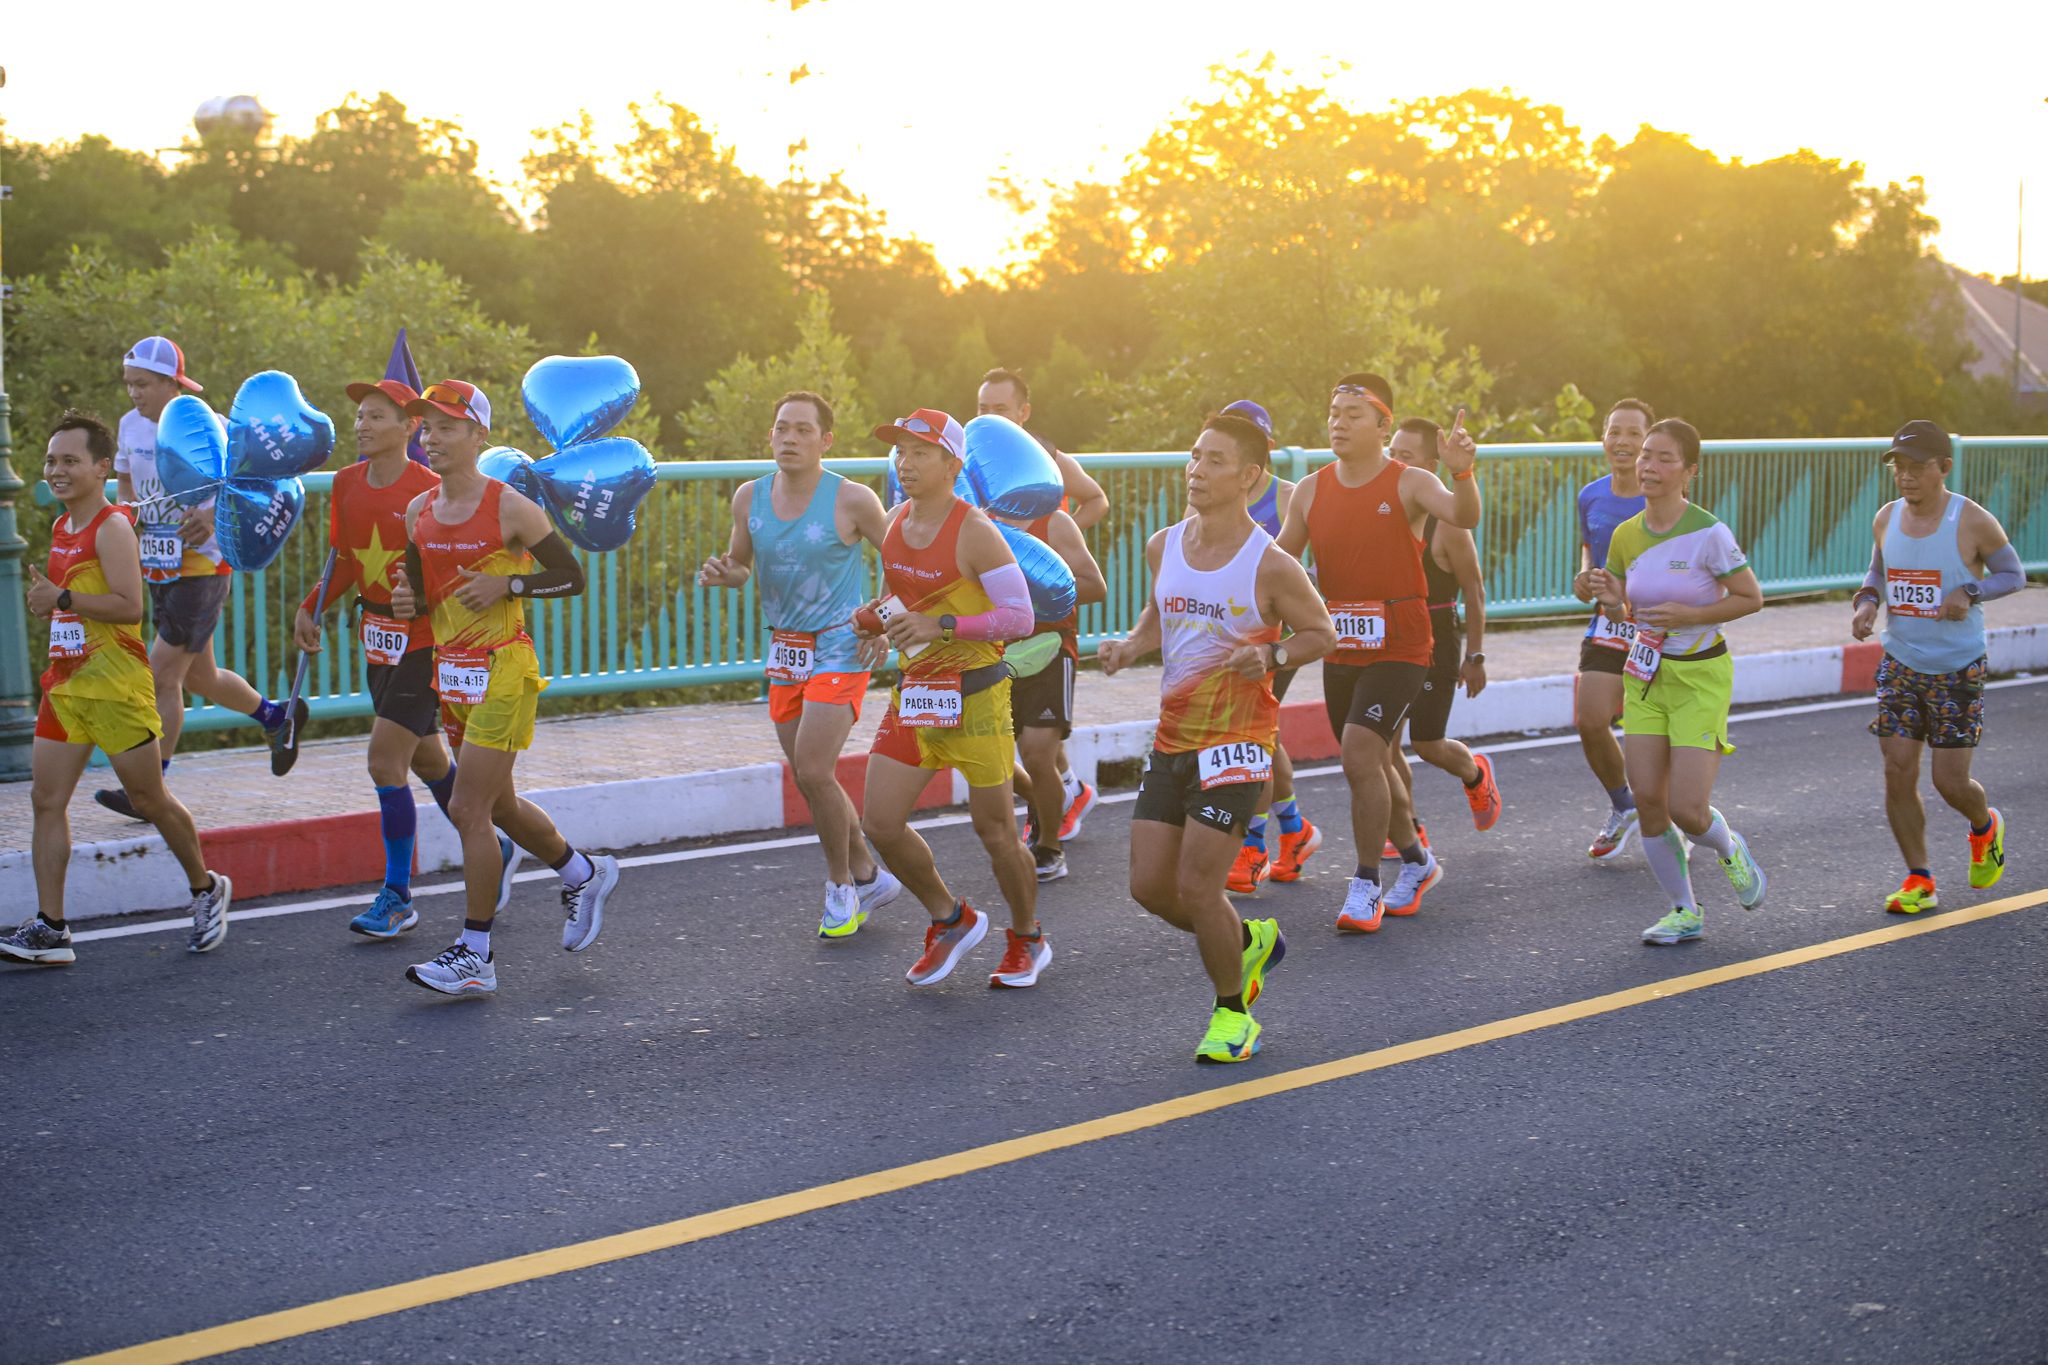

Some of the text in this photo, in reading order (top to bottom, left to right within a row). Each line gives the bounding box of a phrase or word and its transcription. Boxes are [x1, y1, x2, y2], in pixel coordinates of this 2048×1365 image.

[271, 414, 296, 442] FM
[249, 416, 284, 460] 4H15
[570, 469, 597, 522] 4H15
[593, 489, 614, 519] FM
[254, 490, 285, 537] 4H15
[272, 509, 293, 538] FM
[142, 539, 175, 556] 21548
[1893, 585, 1935, 604] 41253
[1164, 597, 1226, 620] HDBank
[51, 630, 80, 642] CER-4:15
[1165, 618, 1223, 636] RUNNERS
[1335, 618, 1374, 636] 41181
[1605, 621, 1635, 640] 4133
[367, 630, 403, 651] 41360
[775, 646, 808, 668] 41599
[441, 673, 484, 687] PACER-4:15
[905, 698, 957, 709] PACER-4:15
[1206, 774, 1246, 787] MARATHON
[1217, 808, 1232, 825] T8
